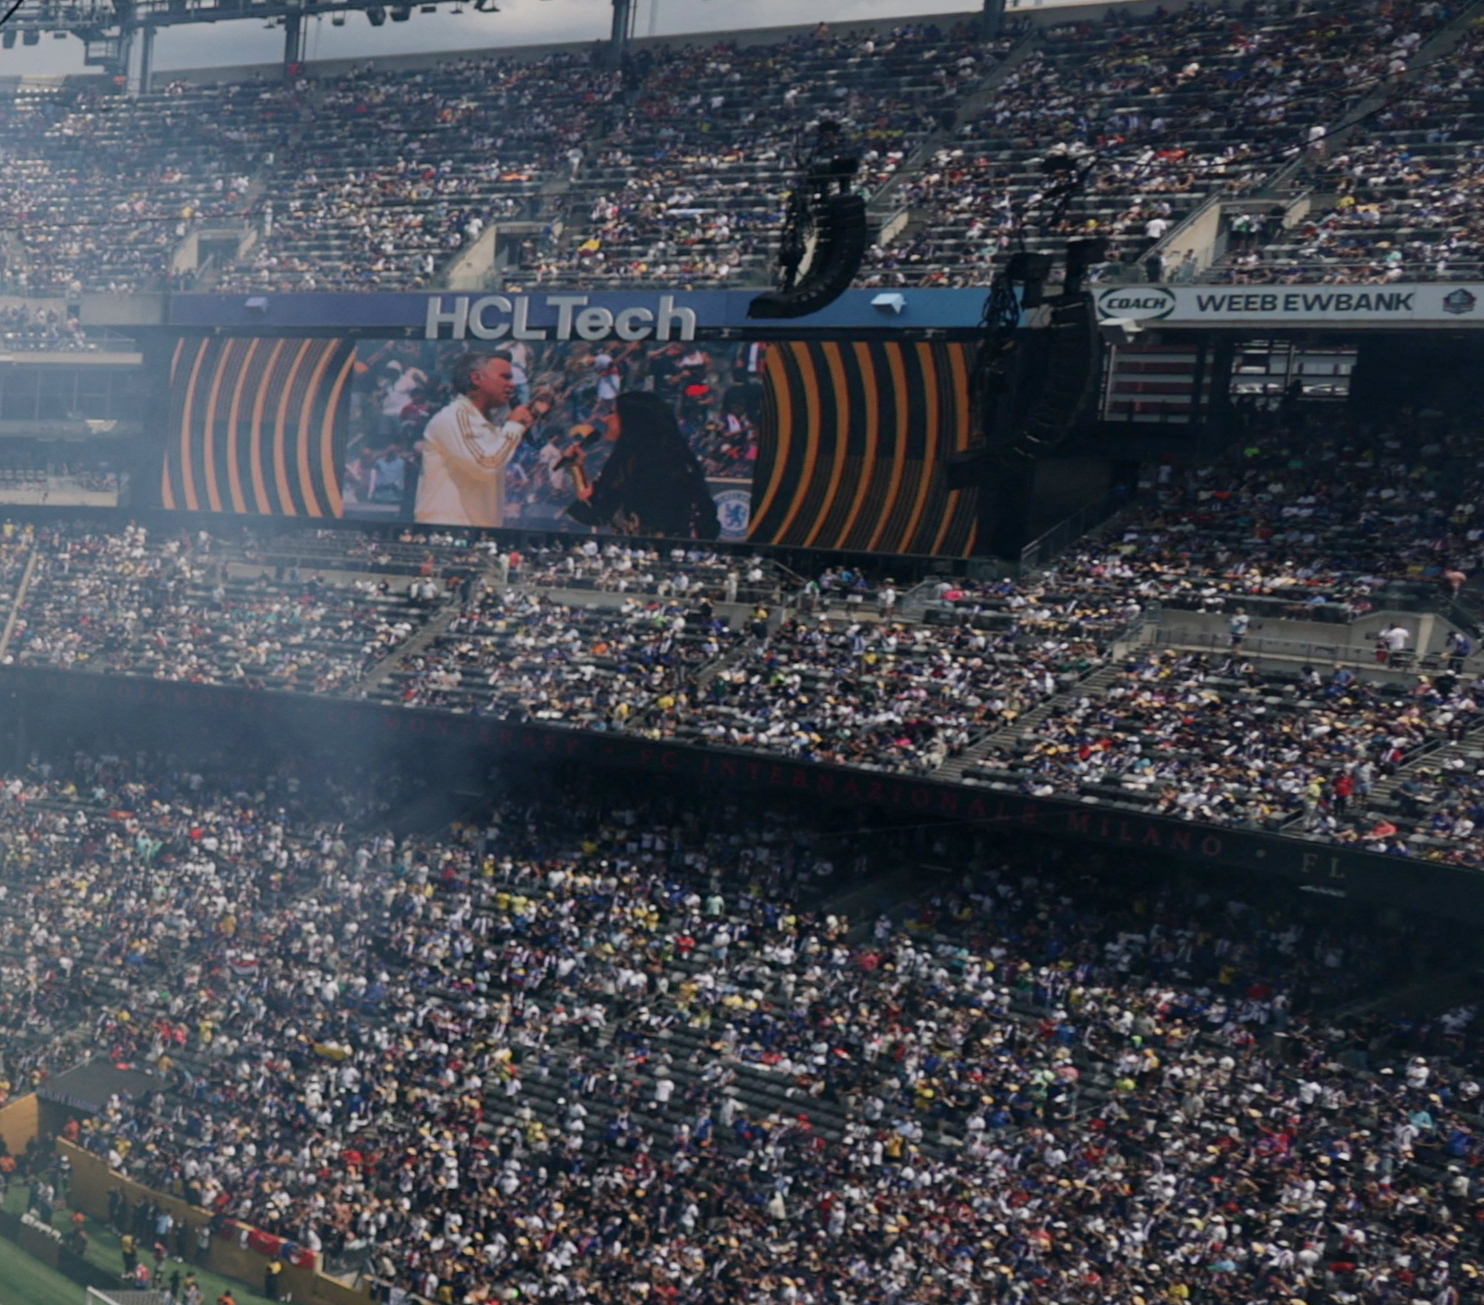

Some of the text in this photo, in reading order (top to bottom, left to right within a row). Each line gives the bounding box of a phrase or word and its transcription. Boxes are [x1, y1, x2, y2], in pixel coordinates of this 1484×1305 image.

[425, 296, 696, 341] HCLTech
[1105, 292, 1415, 313] COACH WEEB EWBANK
[1070, 811, 1224, 856] MILANO
